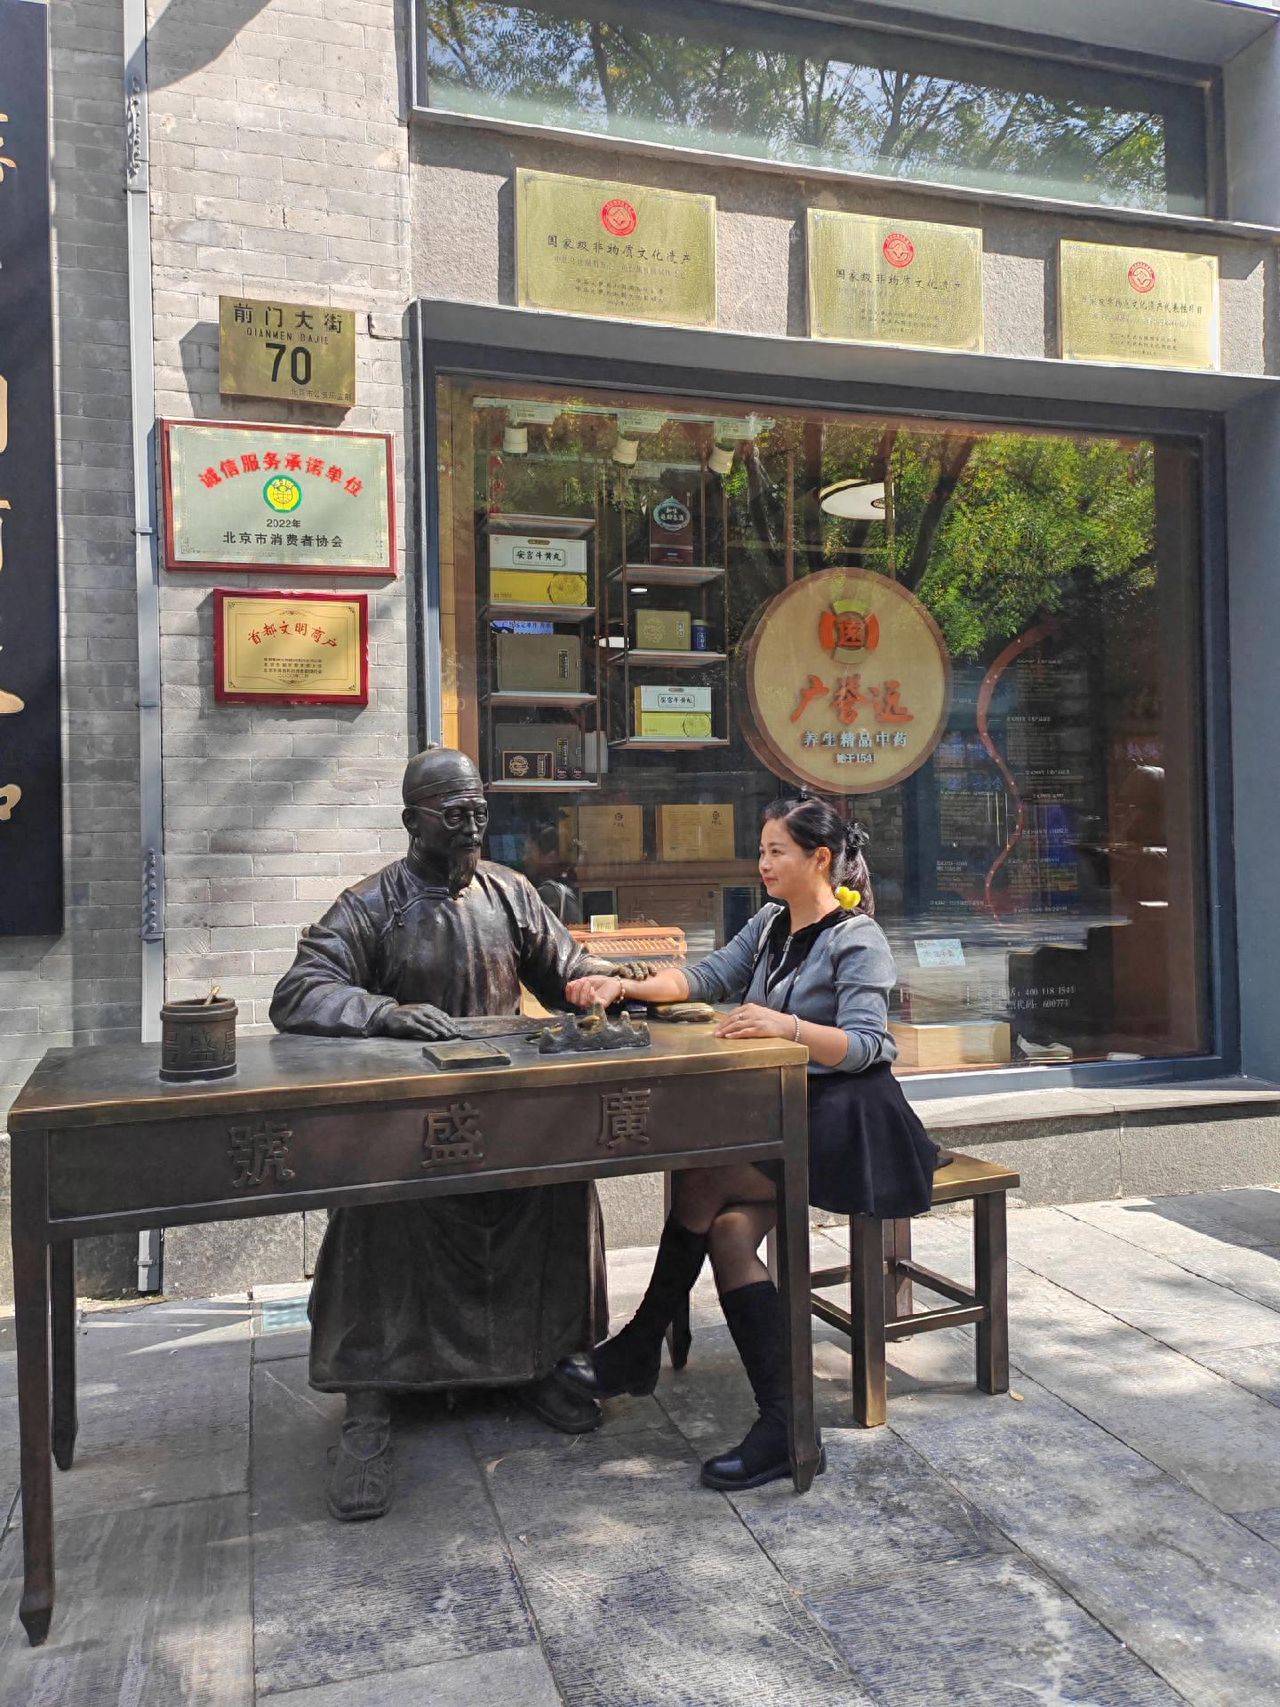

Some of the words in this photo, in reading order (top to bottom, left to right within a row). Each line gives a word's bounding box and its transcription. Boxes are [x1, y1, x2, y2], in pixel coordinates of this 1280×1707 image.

[233, 302, 343, 334] 前门大街
[246, 327, 293, 342] QIANMEN
[300, 333, 329, 345] DAJIE
[265, 342, 312, 386] 70
[198, 451, 365, 498] 诚信服务承诺单位
[266, 518, 302, 529] 2022年
[223, 531, 344, 549] 北京市消费者协会
[515, 550, 563, 562] 安宫牛黄丸
[247, 620, 338, 648] 首都文明商户
[803, 730, 908, 748] 养生精品中药
